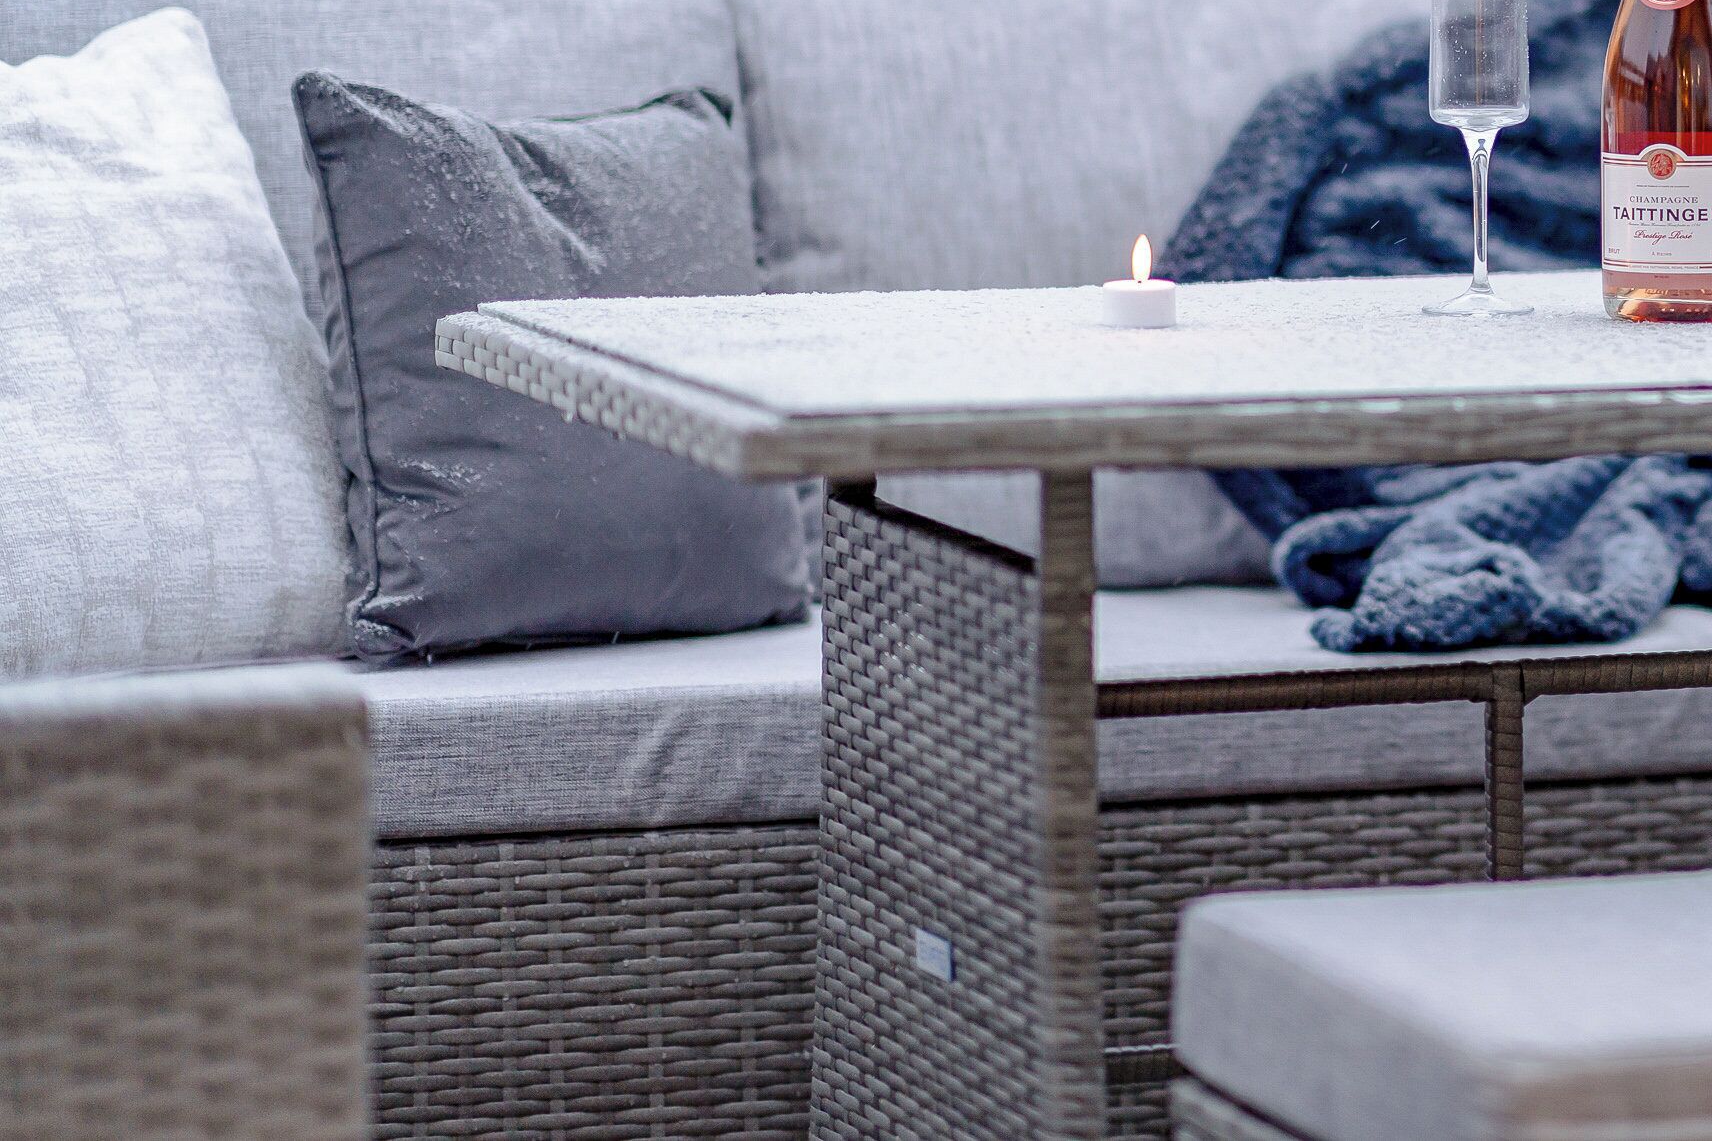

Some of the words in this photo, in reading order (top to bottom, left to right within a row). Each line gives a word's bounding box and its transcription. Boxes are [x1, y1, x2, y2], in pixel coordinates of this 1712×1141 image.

[1629, 195, 1699, 204] CHAMPAGNE
[1633, 229, 1667, 246] Prestige
[1668, 230, 1694, 240] Rosé
